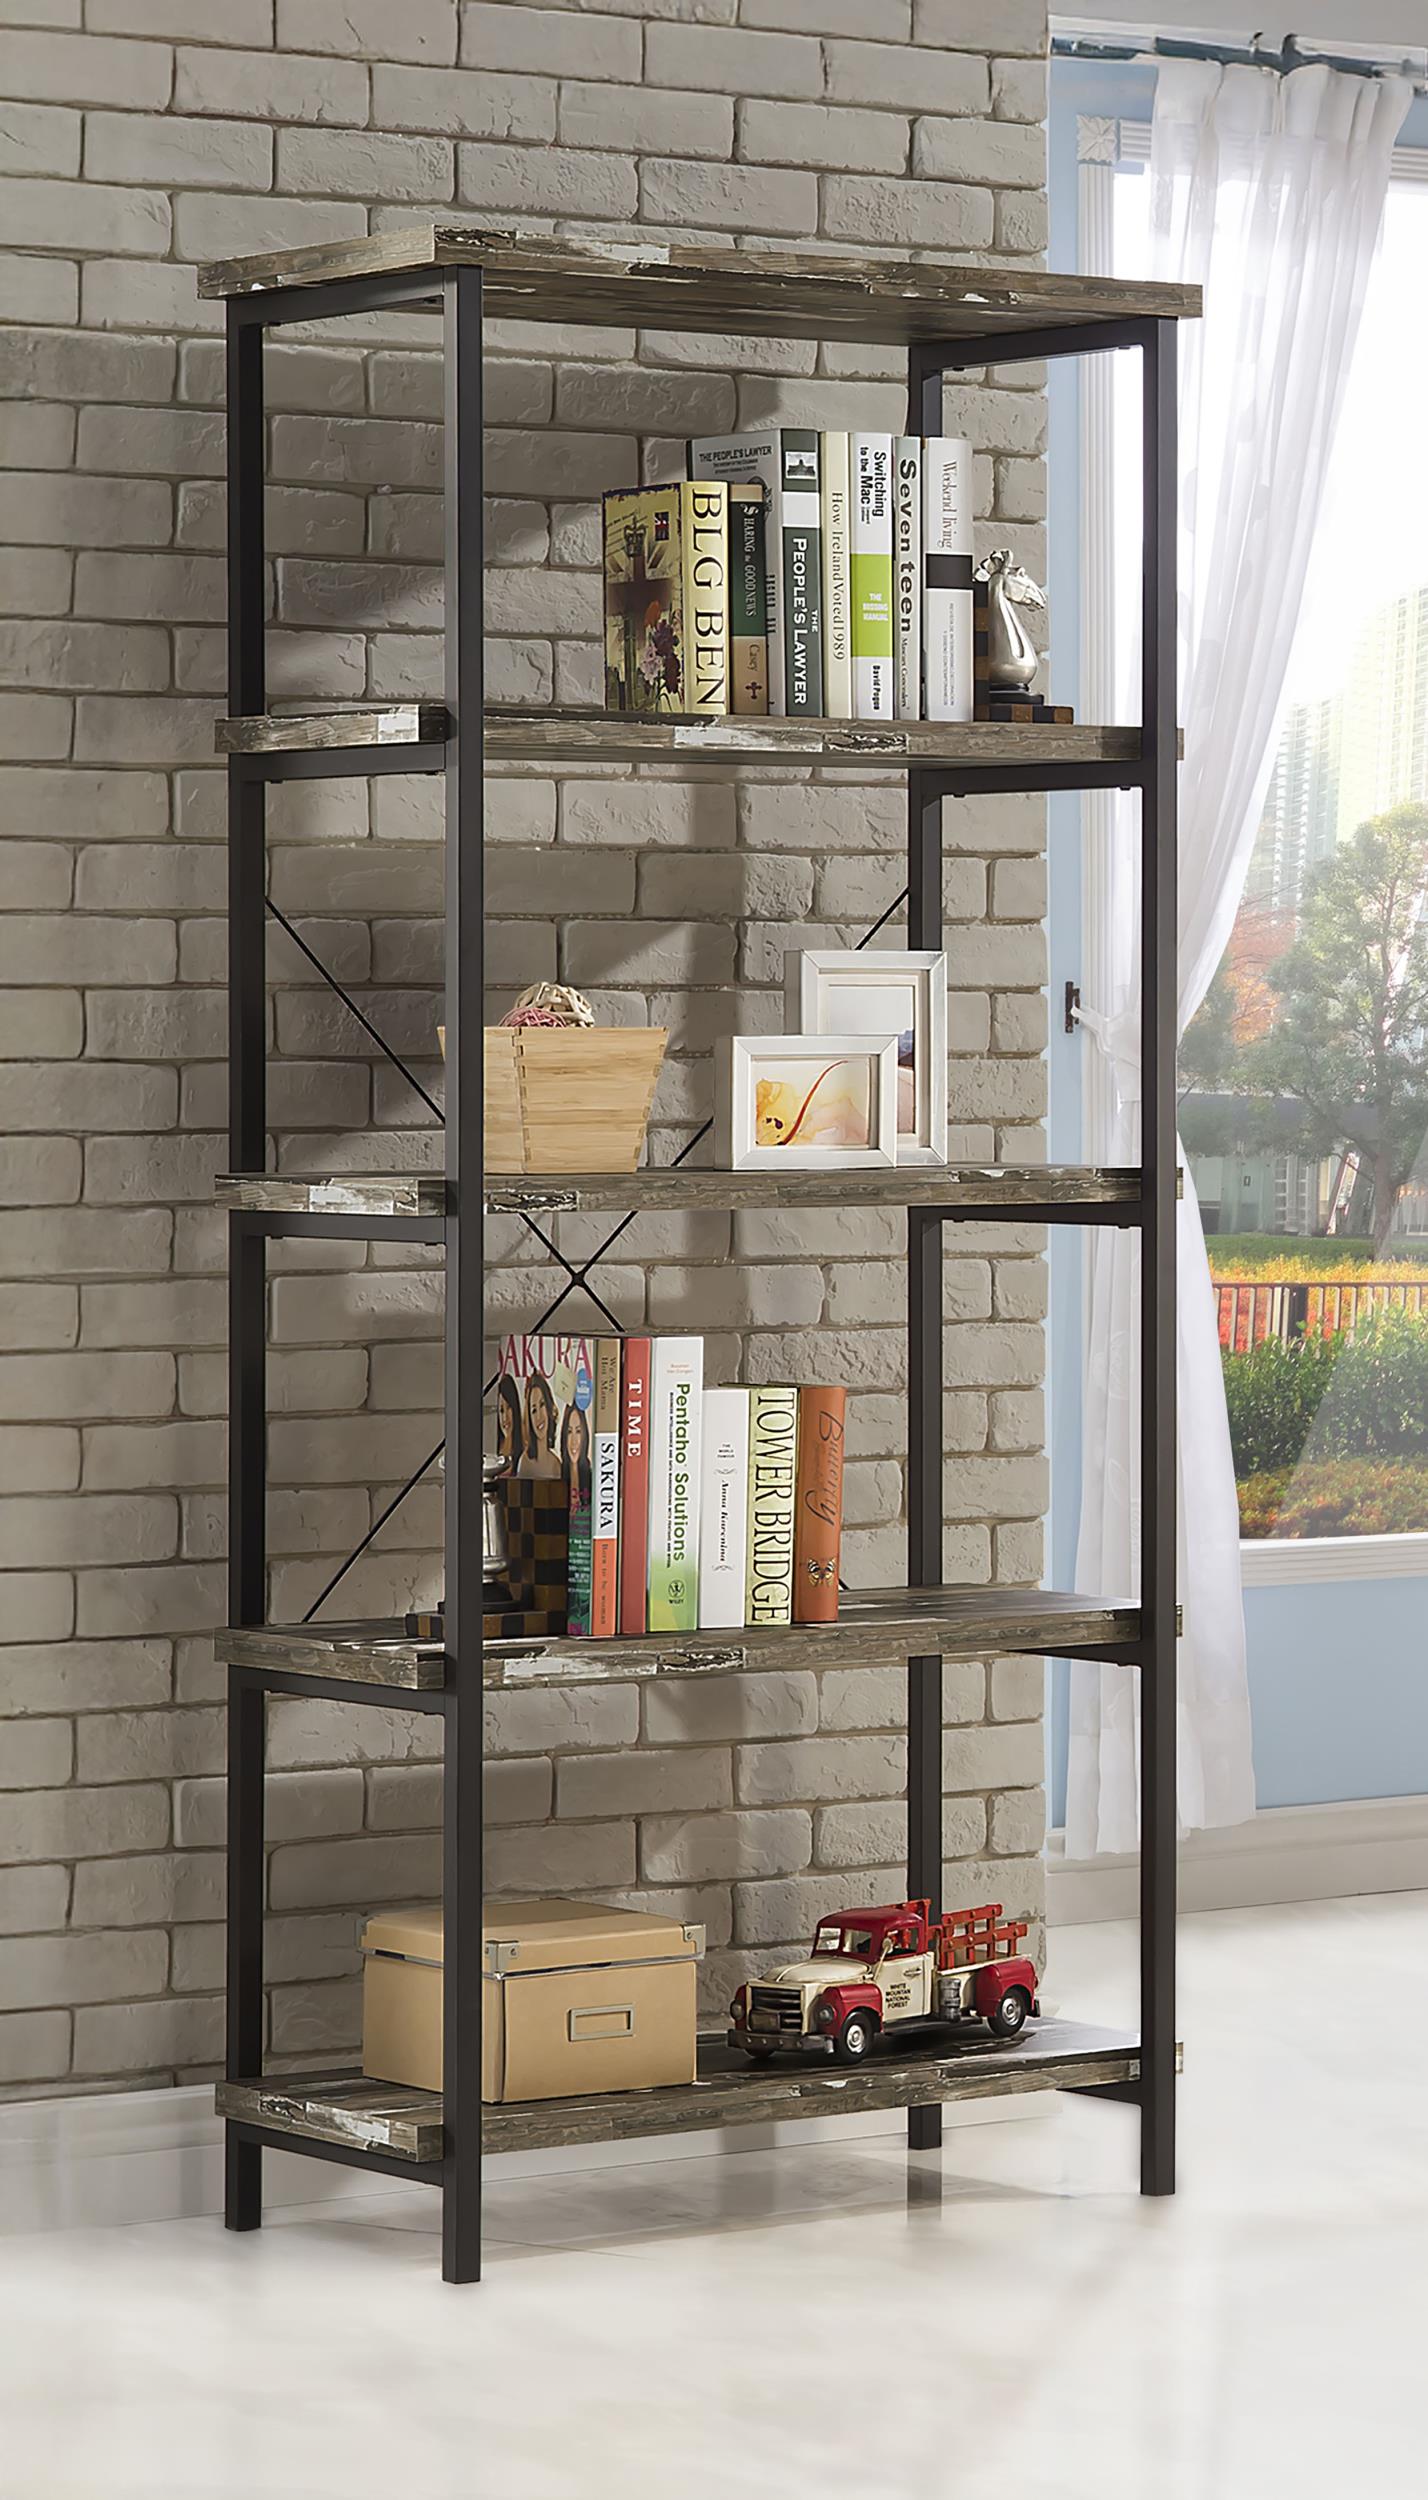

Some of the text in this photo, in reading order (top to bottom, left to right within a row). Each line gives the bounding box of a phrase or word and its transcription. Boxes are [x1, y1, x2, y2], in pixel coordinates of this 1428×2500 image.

[699, 446, 773, 462] THE PEOPLE'S LAWYER
[860, 447, 868, 456] to
[860, 462, 868, 472] the
[872, 451, 887, 517] Switching
[831, 492, 843, 525] How
[860, 475, 873, 505] Mac
[899, 458, 917, 551] Seven
[937, 461, 957, 549] Weekend living
[692, 488, 725, 705] BLG BEN
[793, 538, 808, 705] PEOPLE'S LAWYER
[811, 610, 819, 633] THE
[900, 561, 915, 632] teen
[747, 644, 760, 671] Casey
[627, 1379, 643, 1457] TIME
[600, 1442, 615, 1528] SAKURA
[673, 1384, 690, 1561] Pentaho Solutions
[720, 1511, 728, 1561] Karenina
[751, 1392, 795, 1622] TOWER BRIDGE
[887, 2001, 908, 2009] FOREST
